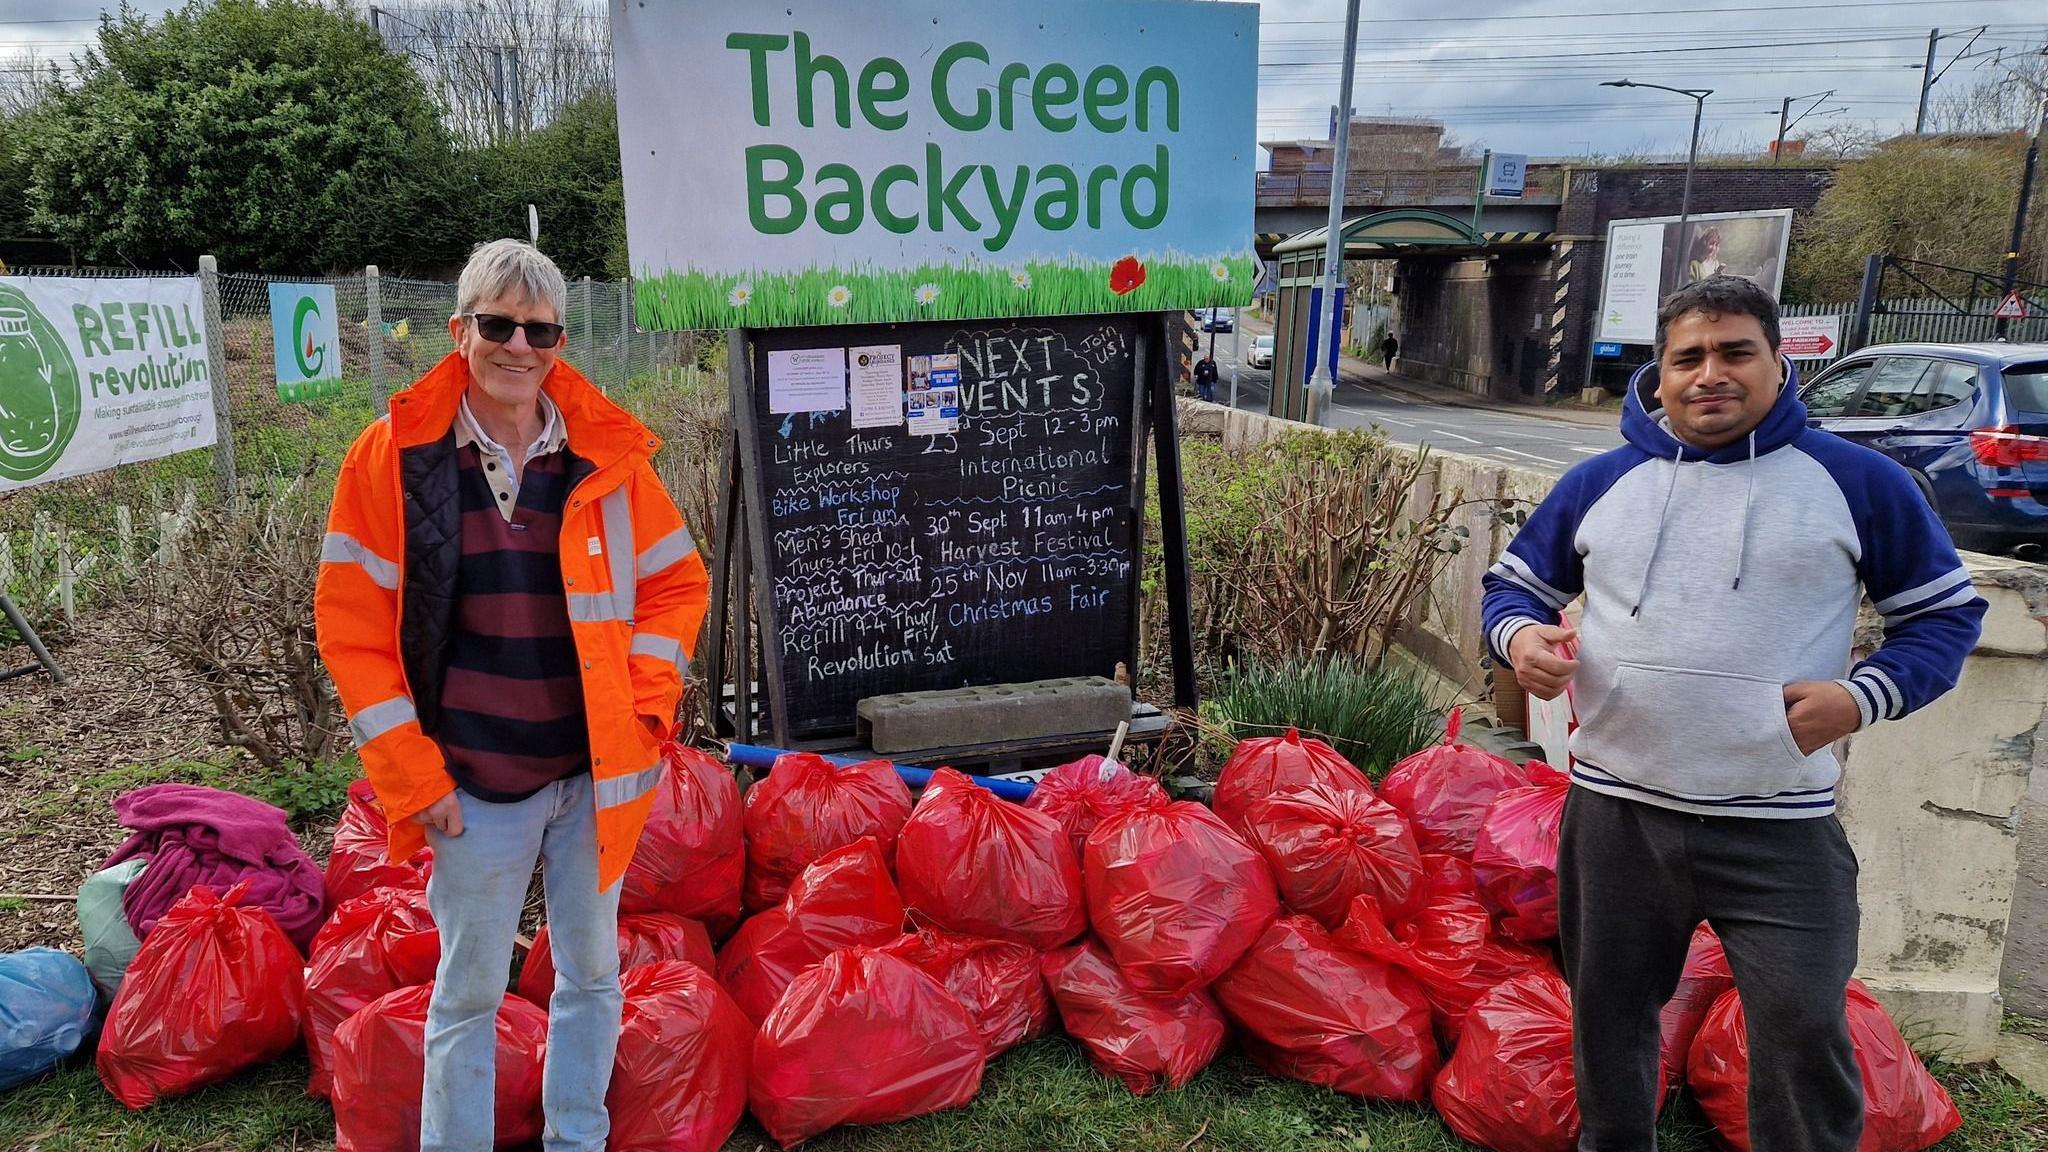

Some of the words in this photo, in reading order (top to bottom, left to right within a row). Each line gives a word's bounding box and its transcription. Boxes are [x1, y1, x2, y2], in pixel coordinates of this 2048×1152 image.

[725, 30, 911, 131] The
[930, 41, 1181, 134] Green
[745, 142, 1171, 253] Backyard
[71, 302, 202, 358] REFILL
[1080, 326, 1118, 354] Join
[89, 352, 208, 399] revolution
[958, 335, 1056, 380] NEXT
[958, 373, 1092, 412] VENTS
[94, 405, 121, 420] Making
[774, 440, 829, 464] Little
[846, 433, 893, 455] Thurs
[980, 415, 1028, 450] Sept
[793, 461, 870, 485] Explorers
[960, 436, 1111, 477] International
[772, 496, 812, 517] Bike
[819, 479, 900, 508] Workshop
[1003, 473, 1069, 499] Picnic
[838, 507, 865, 526] Fri
[872, 508, 897, 524] am
[923, 503, 962, 537] 30th
[968, 508, 1008, 539] Sept
[776, 530, 832, 558] Men's
[840, 525, 884, 549] Shed
[941, 536, 1022, 563] Harvest
[1034, 526, 1113, 554] Festival
[787, 557, 834, 576] Thurs
[852, 544, 875, 565] Fri
[986, 564, 1029, 592] Nov
[775, 575, 844, 608] Project
[791, 592, 887, 625] Abundance
[949, 595, 1053, 628] Christmas
[1070, 583, 1111, 612] Fair
[782, 618, 845, 656] Refill
[855, 617, 887, 637] 9-4
[808, 640, 915, 682] Revolution
[923, 640, 955, 665] Sat
